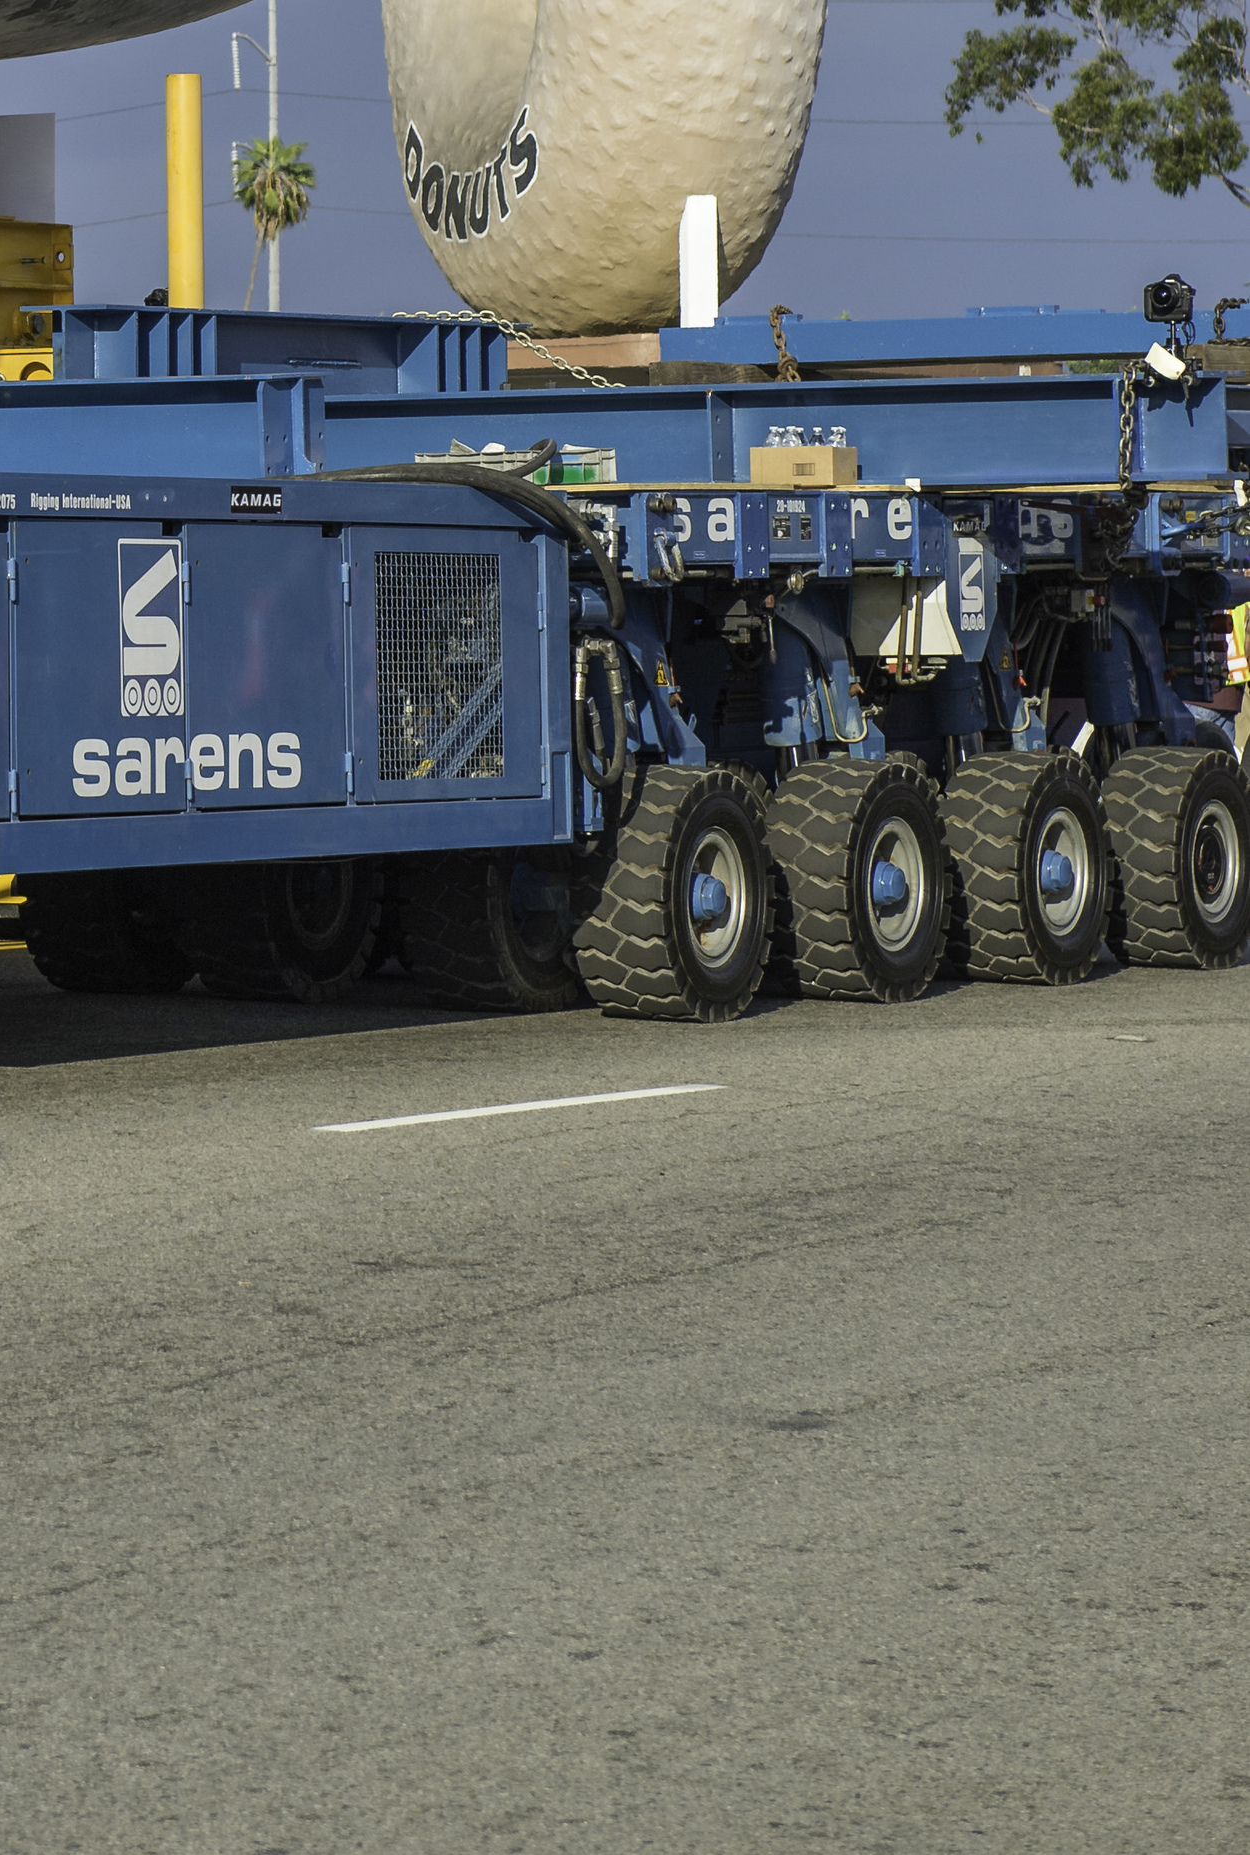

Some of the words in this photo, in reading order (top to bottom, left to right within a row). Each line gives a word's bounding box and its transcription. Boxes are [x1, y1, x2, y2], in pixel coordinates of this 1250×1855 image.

[404, 104, 539, 242] DONUTS
[30, 492, 60, 511] Rigging
[62, 493, 131, 510] International-USA
[231, 492, 282, 507] KAMAG
[72, 731, 302, 798] sarens
